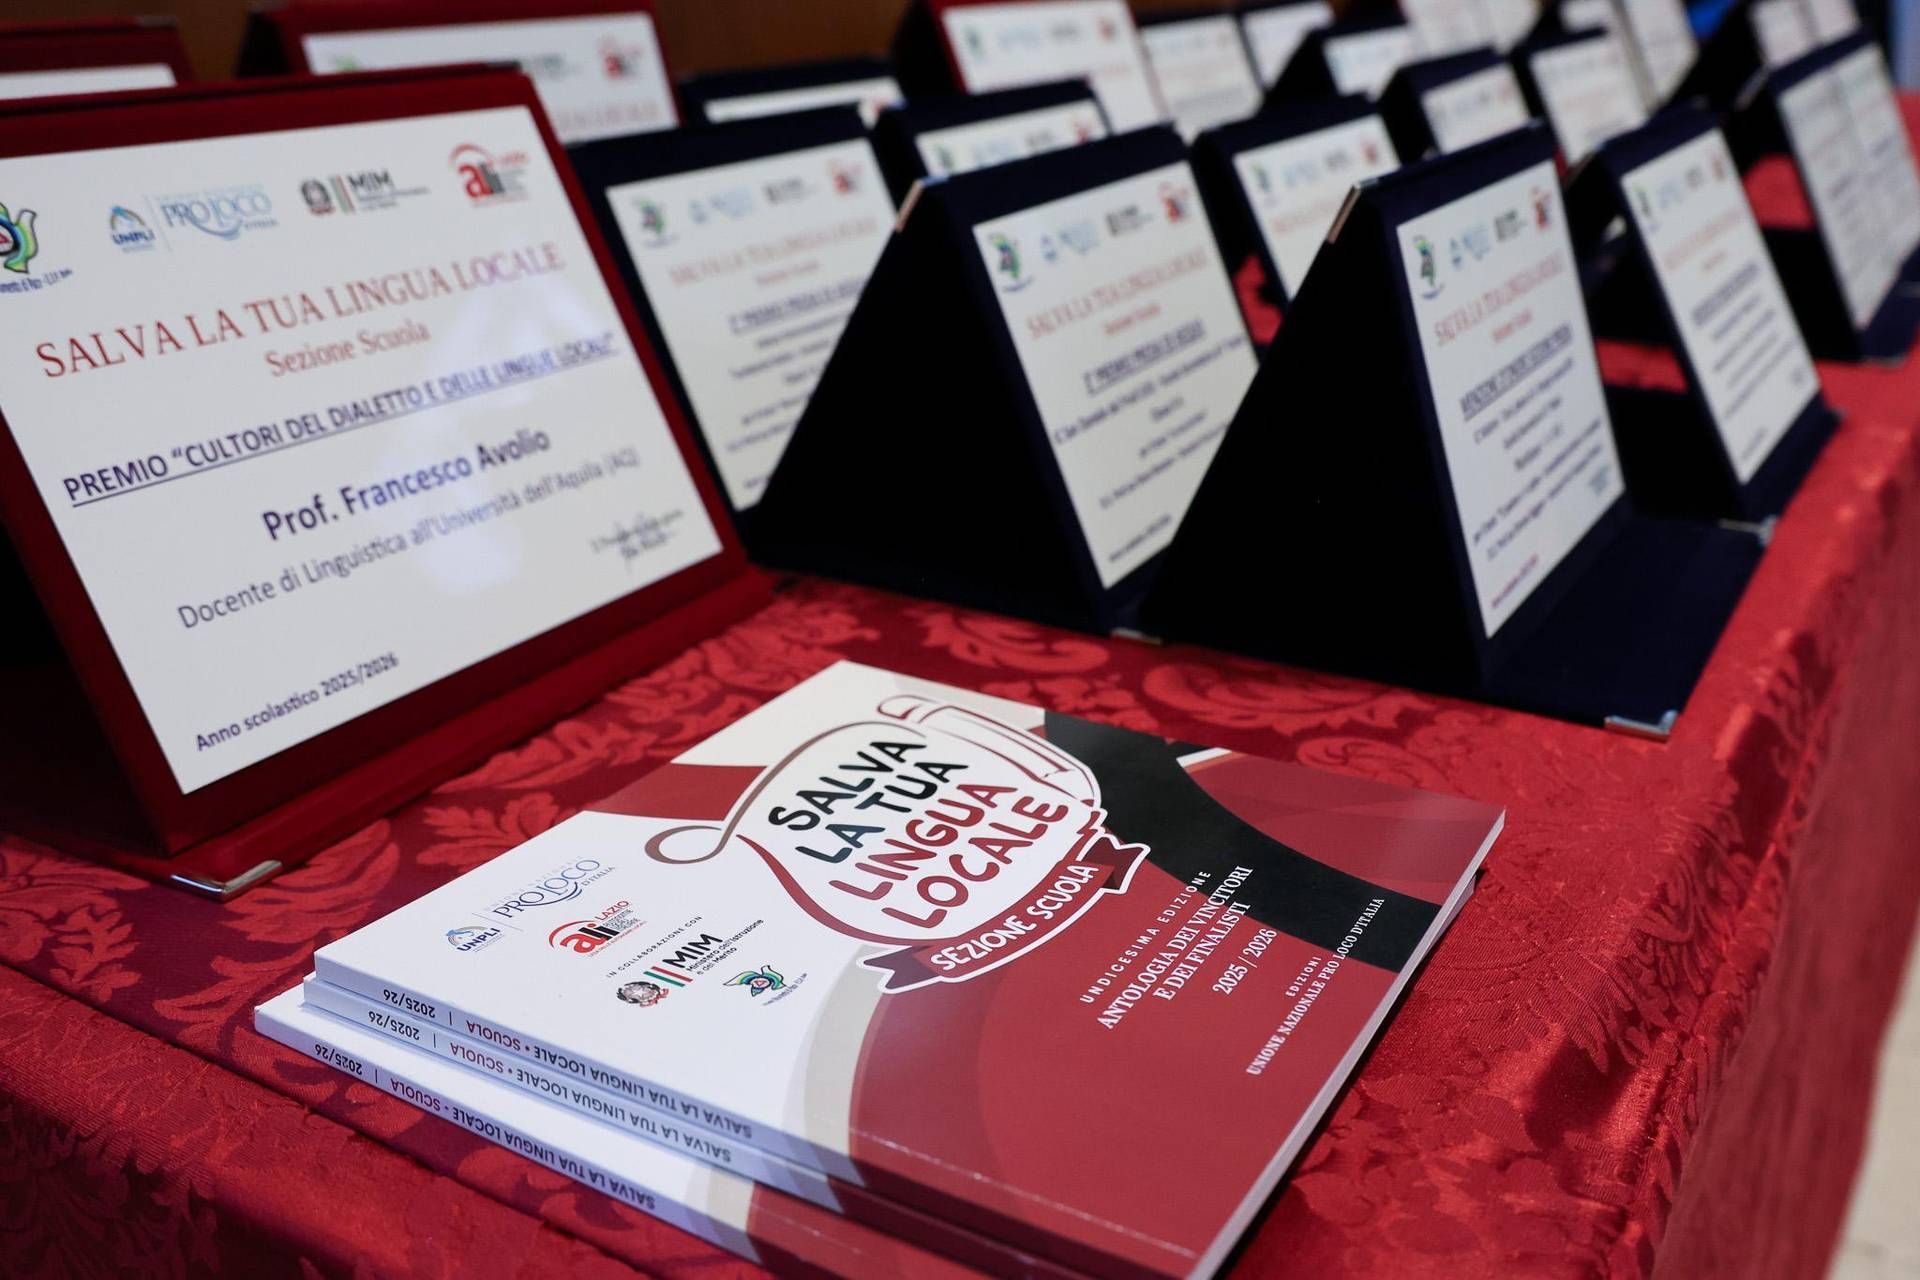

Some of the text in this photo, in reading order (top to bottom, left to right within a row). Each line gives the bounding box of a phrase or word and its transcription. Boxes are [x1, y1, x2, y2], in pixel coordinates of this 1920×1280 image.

[36, 241, 567, 378] SALVA LA TUA LINGUA LOCALE
[264, 318, 431, 378] Sezione Scuola
[63, 454, 169, 502] PREMIO
[172, 423, 284, 468] “CULTORI
[285, 412, 327, 440] DEL
[328, 387, 423, 430] DIALETTO
[424, 381, 437, 402] E
[439, 366, 492, 397] DELLE
[492, 350, 556, 383] LINGUE
[262, 428, 552, 541] Prof. Francesco Avolio
[177, 579, 278, 629] Docente
[280, 568, 303, 593] di
[303, 531, 407, 584] Linguistica
[410, 488, 522, 547] all'Università
[524, 461, 603, 504] dell'Aquila
[195, 651, 399, 752] Anno scolastico 2025/2026
[767, 740, 928, 832] SALVA
[795, 760, 969, 864] LA TUA
[828, 782, 1019, 901] LINGUA
[881, 794, 1069, 929] LOCALE
[456, 927, 502, 952] UNPLI
[594, 900, 629, 921] LAZIO
[606, 915, 703, 978] IN COLLABORAZIONE CON
[662, 933, 723, 969] MIM
[686, 949, 720, 972] Ministero
[712, 946, 737, 963] Merito
[930, 861, 1101, 973] SEZIONE SCUOLA
[1080, 870, 1211, 1004] UNDICESIMA EDIZIONE
[1097, 865, 1254, 1030] ANTOLOGIA DEI VINCITORI
[1153, 901, 1252, 1001] E DEI FINALISTI
[1212, 963, 1248, 995] 2025
[1242, 928, 1278, 958] 2026
[1246, 897, 1385, 1076] UNIONE NAZIONALE PRO LOCO D'ITALIA
[1285, 956, 1322, 998] EDIZIONI
[368, 1010, 733, 1163] SALVA LA TUA LINGUA LOCALE SCUOLA 2025/26
[382, 988, 753, 1138] SALVA LA TUA LINGUA LOCALE SCUOLA 2025/26
[314, 1043, 656, 1210] SALVA LA TUA LINGUA LOCALE SCUOLA 2025/26
